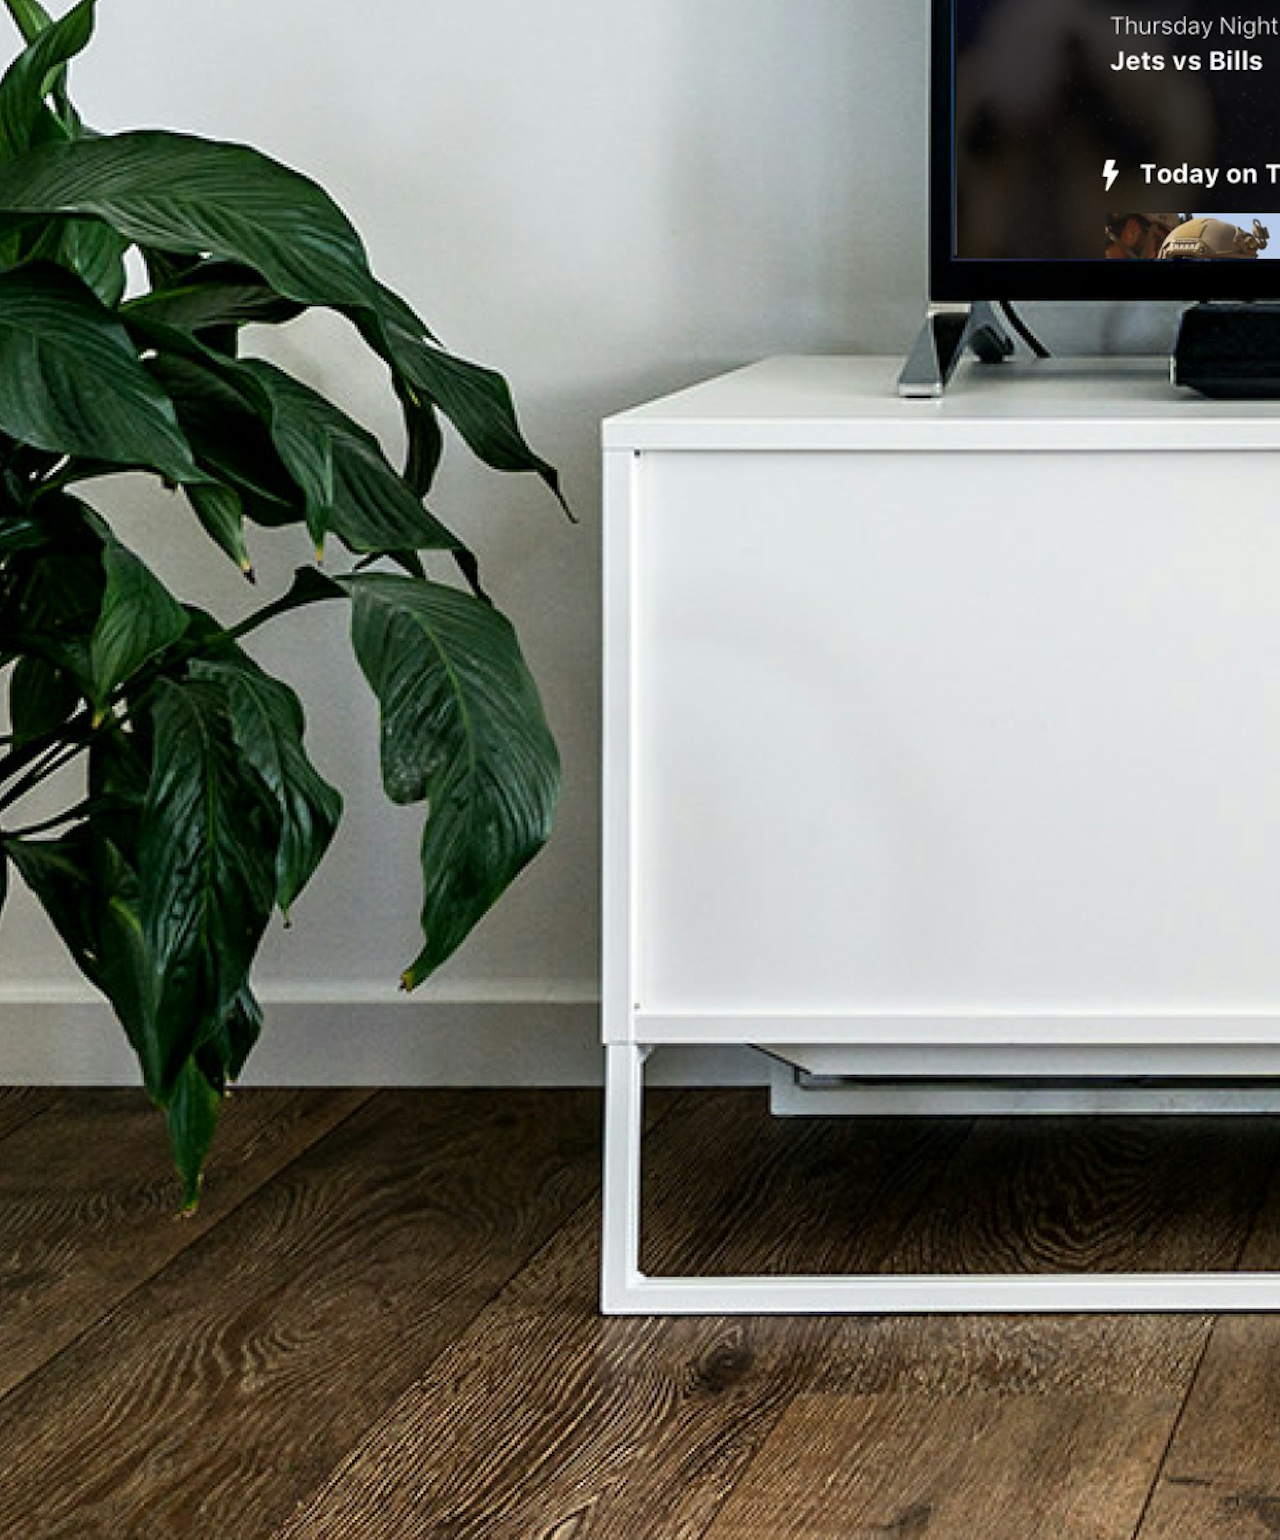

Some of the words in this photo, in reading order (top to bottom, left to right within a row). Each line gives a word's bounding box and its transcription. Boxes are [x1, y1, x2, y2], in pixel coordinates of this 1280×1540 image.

[1111, 16, 1212, 39] Thursday
[1220, 16, 1279, 39] Night
[1111, 51, 1165, 70] Jets
[1173, 55, 1201, 70] vs
[1210, 50, 1262, 70] Bills
[1140, 163, 1219, 188] Today
[1227, 168, 1257, 183] on
